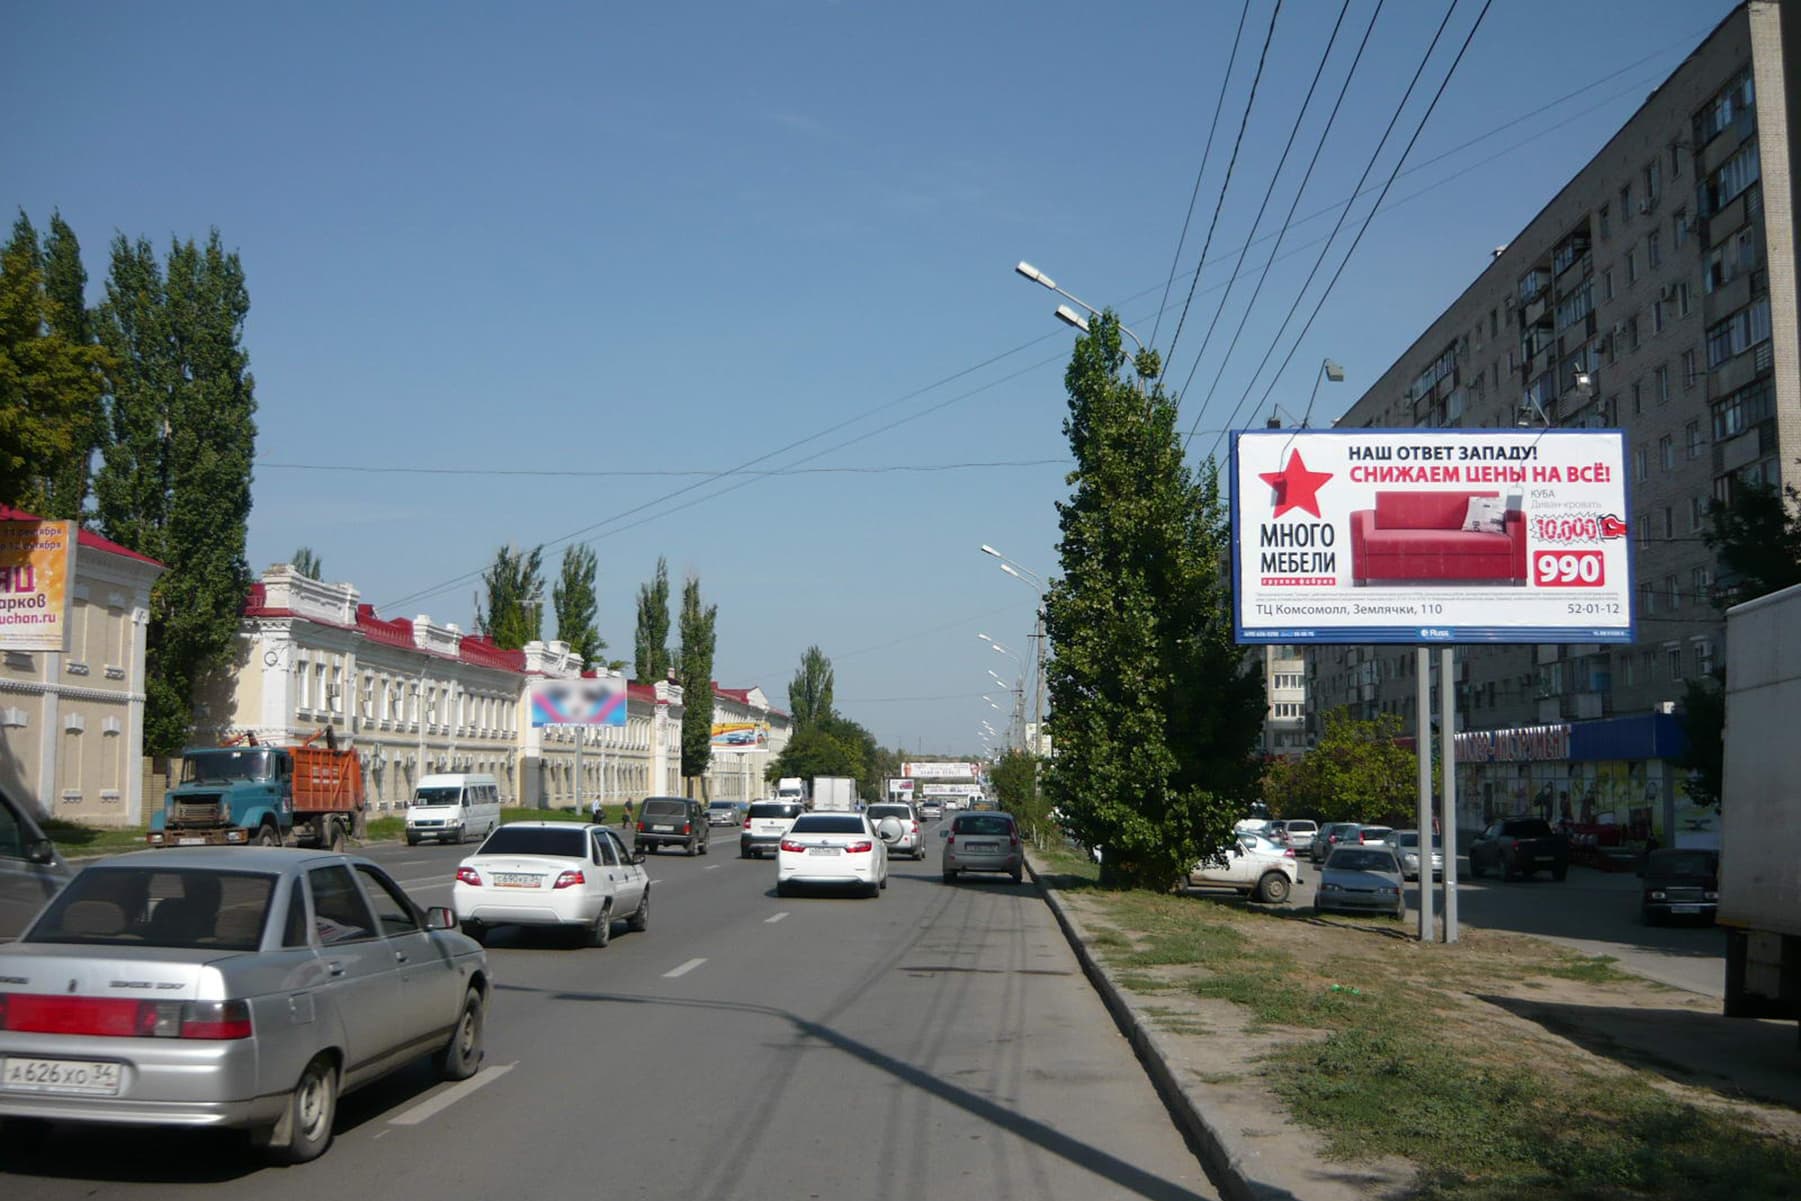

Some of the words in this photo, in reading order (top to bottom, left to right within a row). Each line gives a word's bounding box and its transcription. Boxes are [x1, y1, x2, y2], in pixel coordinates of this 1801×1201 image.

[1348, 446, 1392, 460] НАШ
[1396, 446, 1454, 460] ОТВЕТ
[1458, 446, 1538, 460] ЗАПАДУ!
[1349, 466, 1460, 483] СНИЖАЕМ
[1465, 466, 1526, 483] ЦЕНЫ
[1532, 466, 1562, 483] НА
[1566, 462, 1611, 483] ВСЁ!
[1530, 489, 1556, 499] КУБА
[1260, 523, 1335, 548] МНОГО
[1261, 551, 1336, 573] МЕБЕЛИ
[1256, 604, 1273, 616] ТЦ
[1276, 604, 1350, 616] Комсомолл,
[1353, 604, 1417, 616] Землячки,
[1421, 604, 1443, 615] 110
[1567, 603, 1620, 614] 52-01-12
